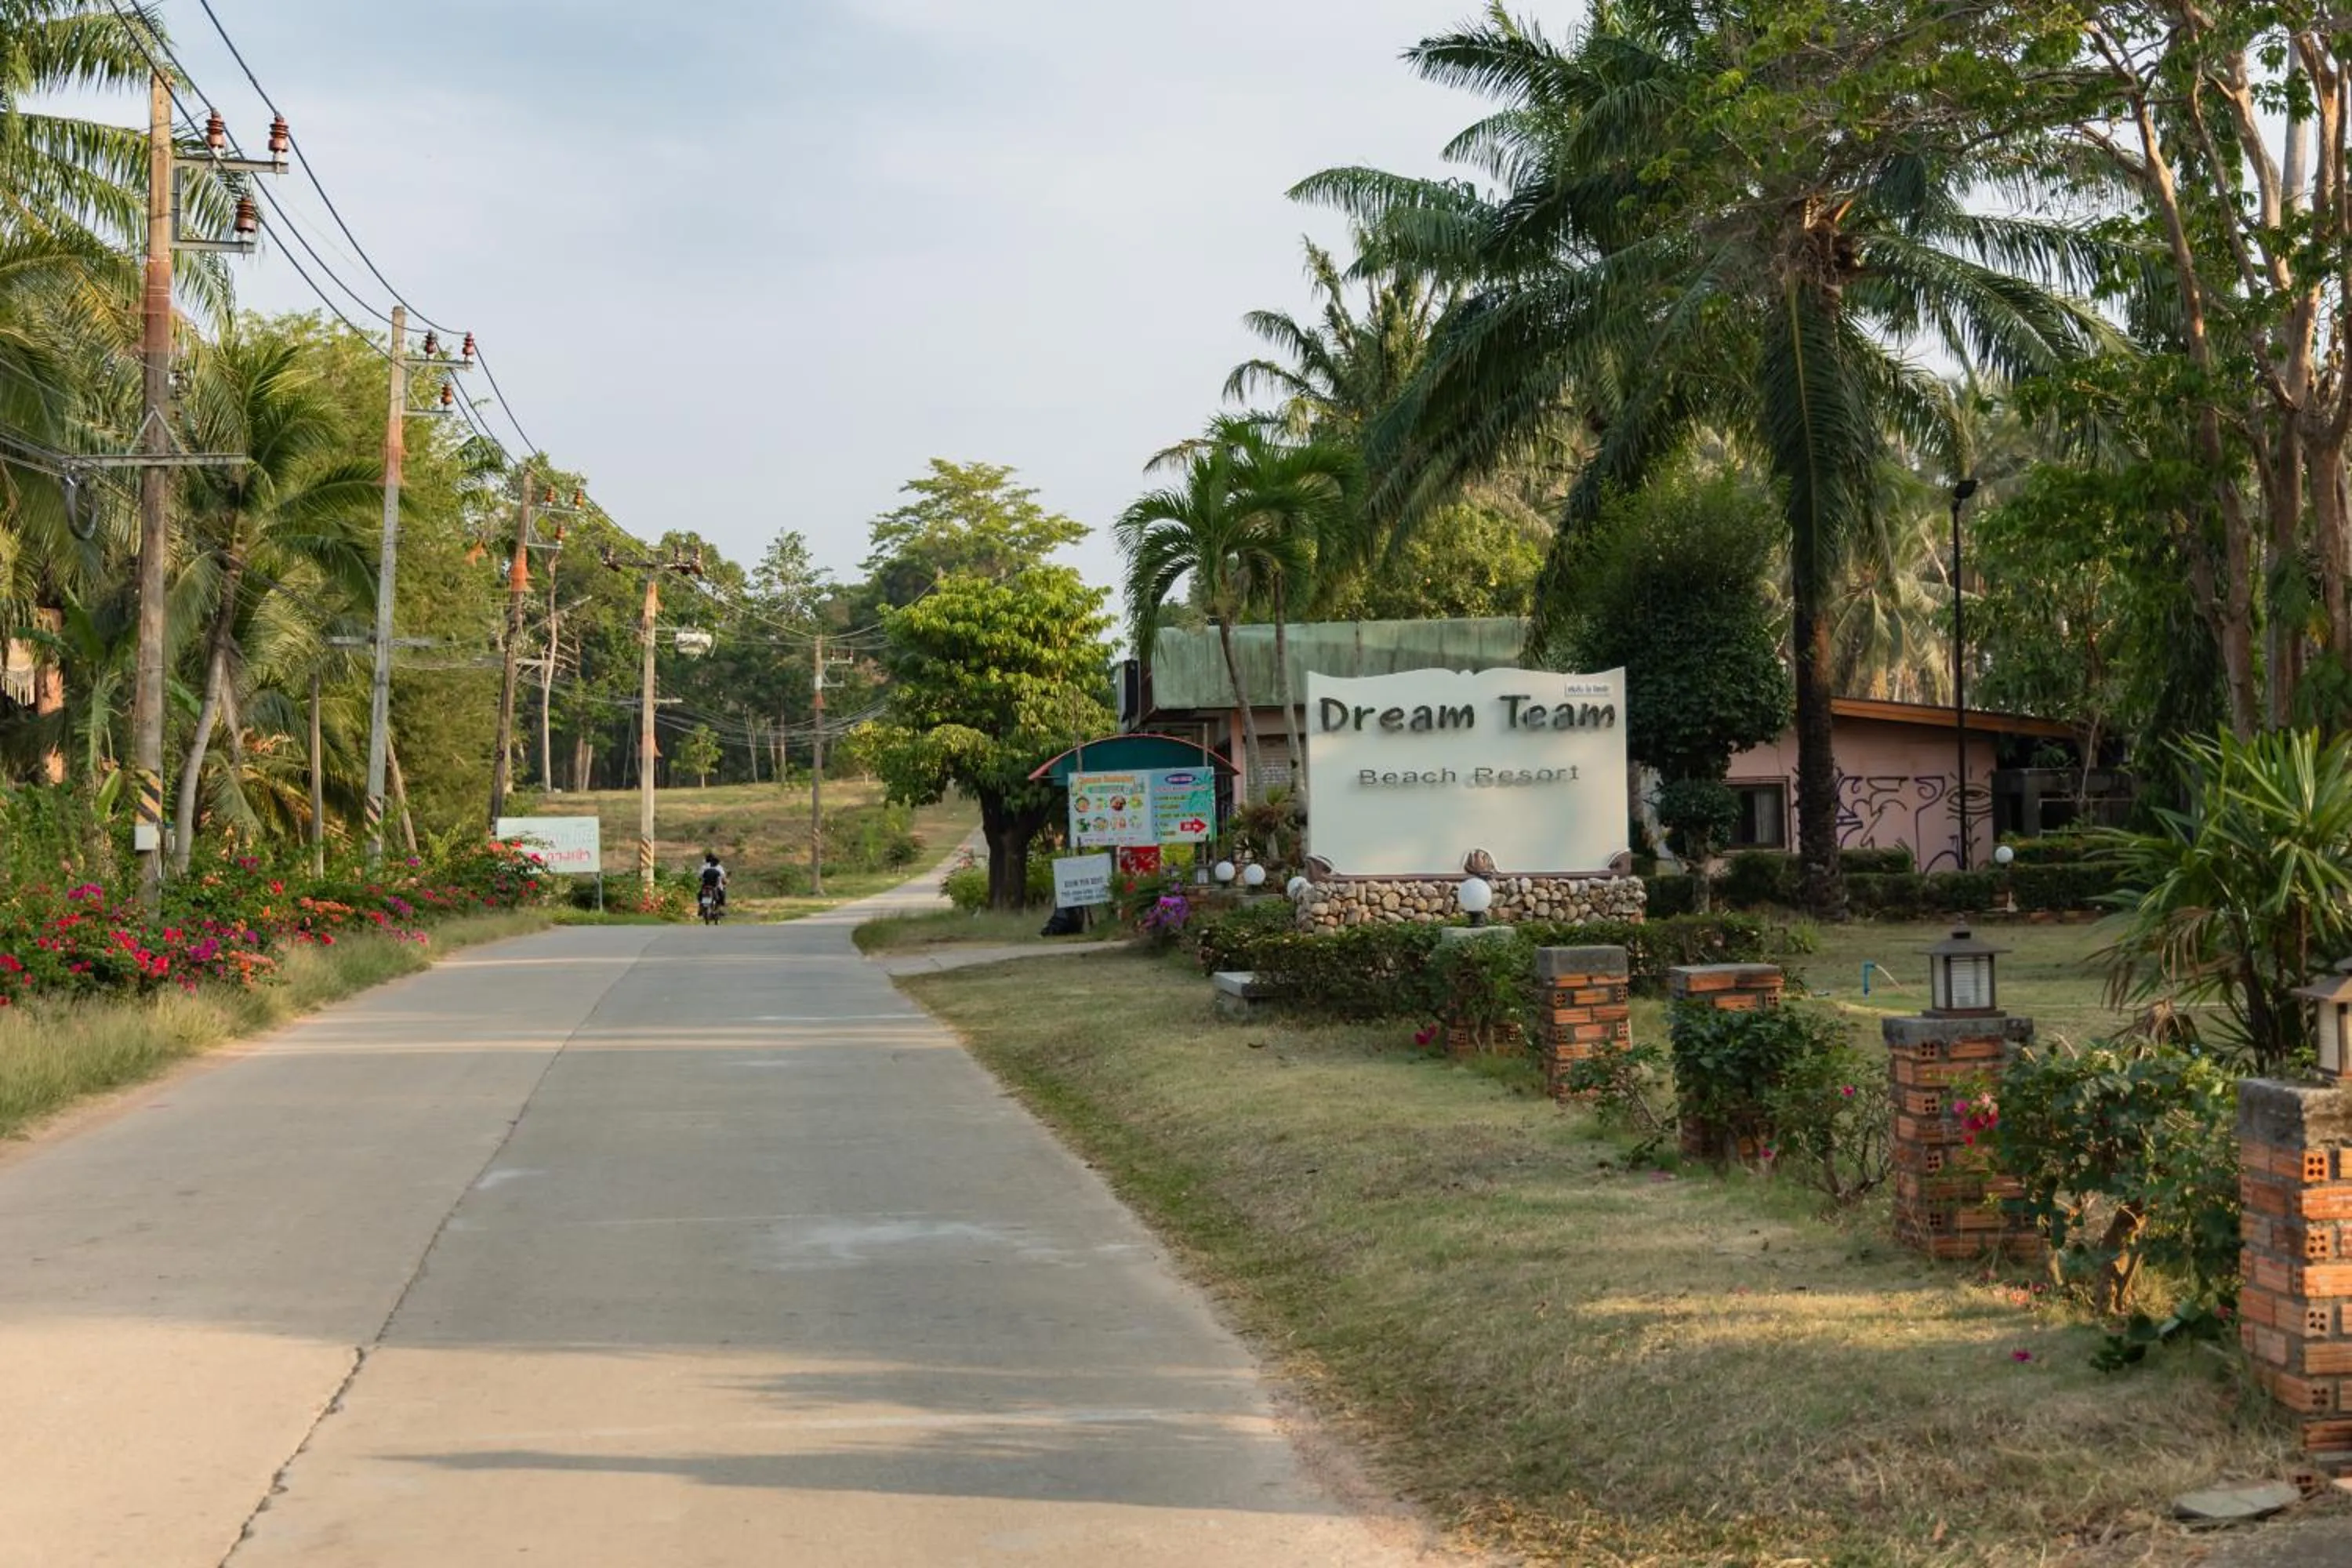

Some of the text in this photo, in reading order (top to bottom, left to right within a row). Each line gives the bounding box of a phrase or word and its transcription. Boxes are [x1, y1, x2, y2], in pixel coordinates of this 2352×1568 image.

[1319, 695, 1616, 732] Dream Team
[1359, 765, 1580, 785] Beach Resort
